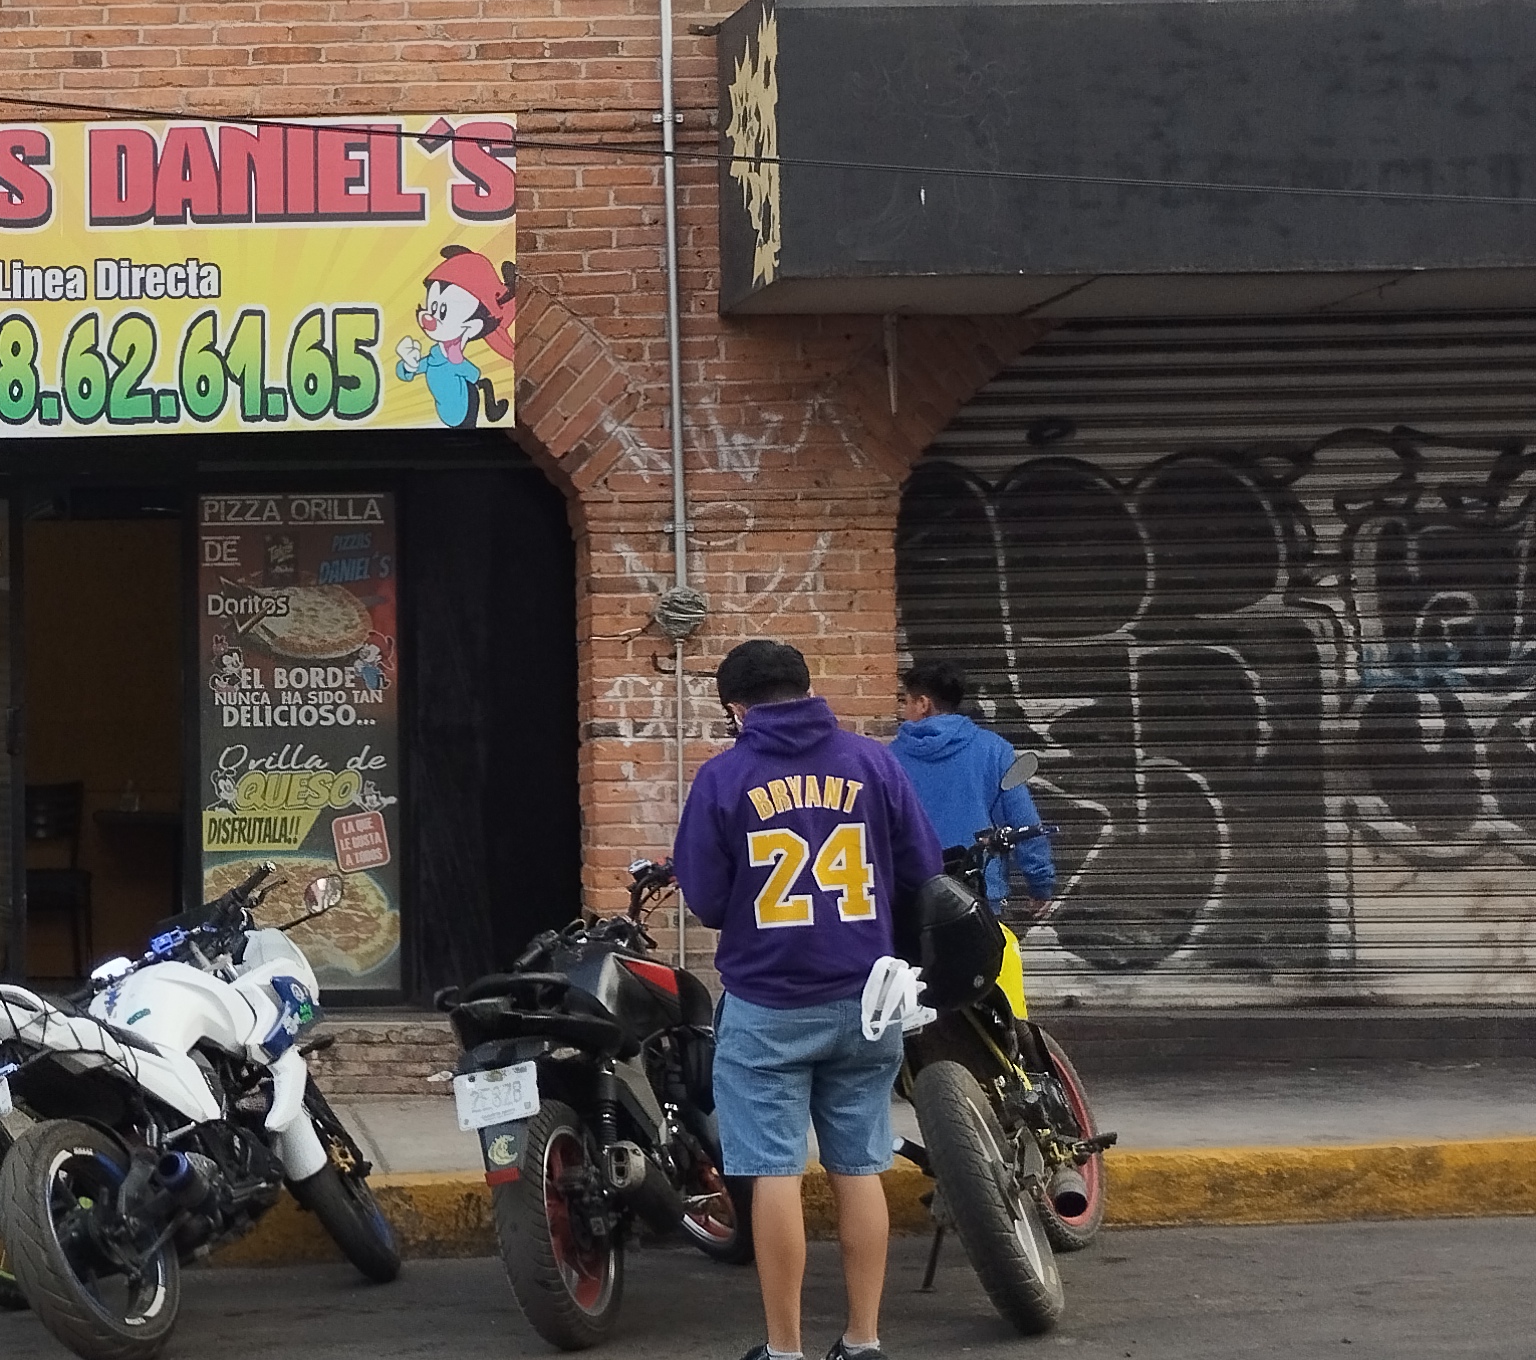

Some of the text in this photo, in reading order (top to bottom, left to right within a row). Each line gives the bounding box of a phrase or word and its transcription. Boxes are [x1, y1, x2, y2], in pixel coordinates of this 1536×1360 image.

[94, 258, 221, 301] Directa
[204, 499, 382, 521] PIZZA ORILLA
[204, 540, 239, 562] DE
[332, 533, 372, 551] PIZZAS
[208, 592, 290, 618] Doritos
[241, 667, 356, 689] EL BORDE
[214, 690, 383, 705] NUNCA HA SIDO TAN
[223, 704, 376, 727] DELICIOSO...
[219, 743, 387, 770] Orilla de
[236, 769, 363, 810] QUESO
[747, 775, 864, 821] BRYANT
[207, 815, 302, 845] DISFRUTALA!!
[342, 821, 355, 834] LA
[339, 838, 352, 851] LE
[346, 854, 354, 866] A
[747, 822, 877, 929] 24
